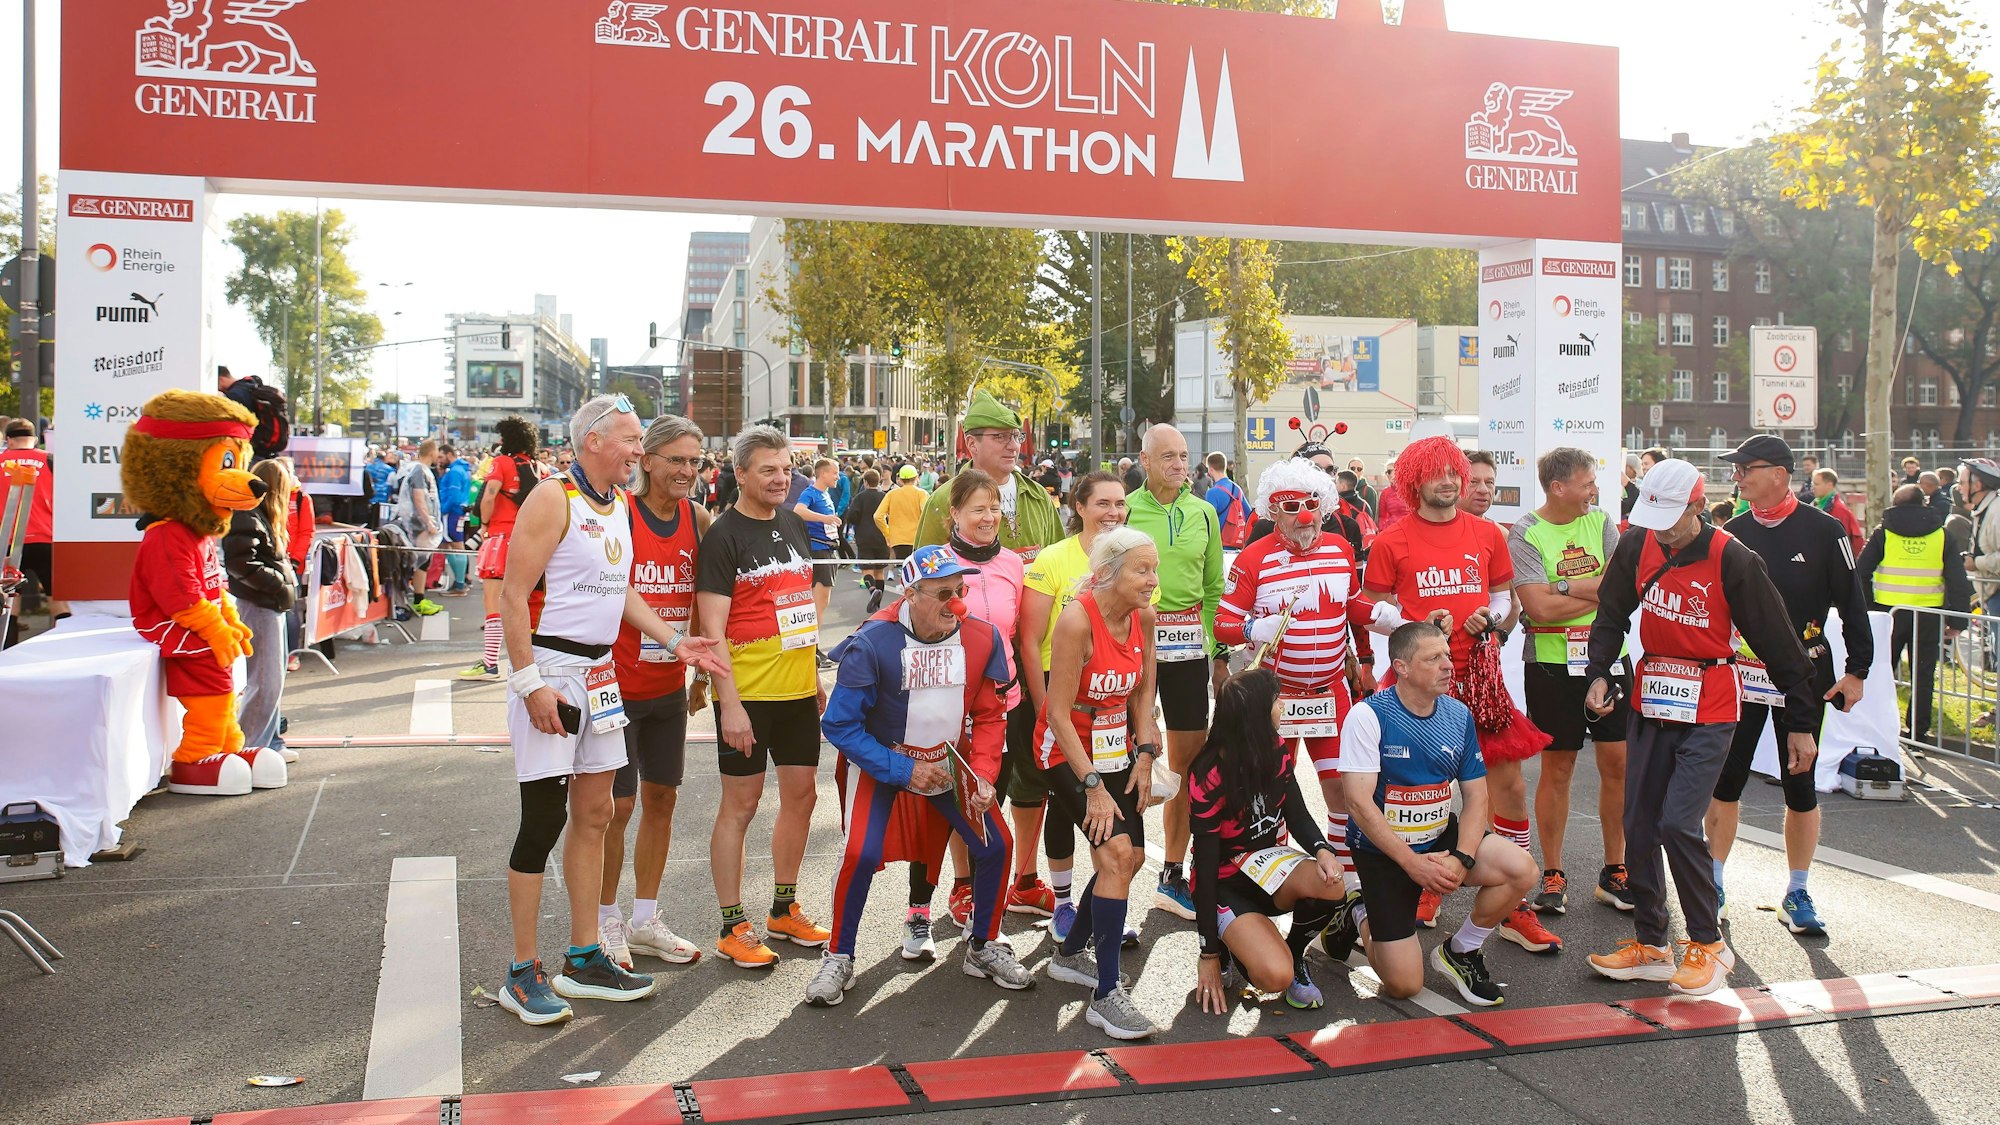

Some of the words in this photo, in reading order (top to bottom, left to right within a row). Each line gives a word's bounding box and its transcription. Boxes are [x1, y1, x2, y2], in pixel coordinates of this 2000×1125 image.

[674, 5, 918, 66] GENERALI
[930, 25, 1156, 118] KÖLN
[134, 83, 317, 124] GENERALI
[702, 80, 835, 160] 26.
[857, 117, 1156, 177] MARATHON
[1465, 164, 1579, 195] GENERALI
[101, 199, 189, 219] GENERALI
[123, 248, 162, 260] Rhein
[123, 260, 175, 274] Energie
[1494, 261, 1532, 279] GENERALI
[1561, 261, 1614, 276] GENERALI
[1503, 300, 1521, 310] Rhein
[1574, 299, 1598, 308] Rhein
[96, 306, 149, 323] PUMA
[1503, 309, 1526, 319] Energie
[1574, 308, 1606, 319] Energie
[1766, 332, 1807, 342] Zoobrücke
[1493, 346, 1515, 359] PUMA
[1559, 343, 1591, 357] PUMA
[94, 346, 165, 373] Reissdorf
[1492, 375, 1521, 397] Reissdorf
[1558, 374, 1600, 395] Reissdorf
[1761, 379, 1787, 388] Tunnel
[1790, 379, 1807, 388] Kalk
[1497, 419, 1525, 434] pixum
[1565, 419, 1605, 434] pixum
[1247, 440, 1274, 449] BAUER
[1273, 493, 1296, 502] Köln
[600, 570, 626, 582] Deutsche
[635, 560, 675, 584] KÖLN
[1416, 566, 1462, 588] KÖLN
[1158, 630, 1196, 642] Peter
[911, 648, 953, 669] SUPER
[909, 666, 953, 689] MICHEL
[1654, 662, 1701, 677] GENERALI
[1089, 669, 1137, 693] KÖLN
[1649, 681, 1690, 699] Klaus
[1690, 684, 1699, 701] 2701
[1287, 701, 1329, 716] Josef
[1404, 785, 1450, 802] GENERALI
[1399, 806, 1444, 823] Horst
